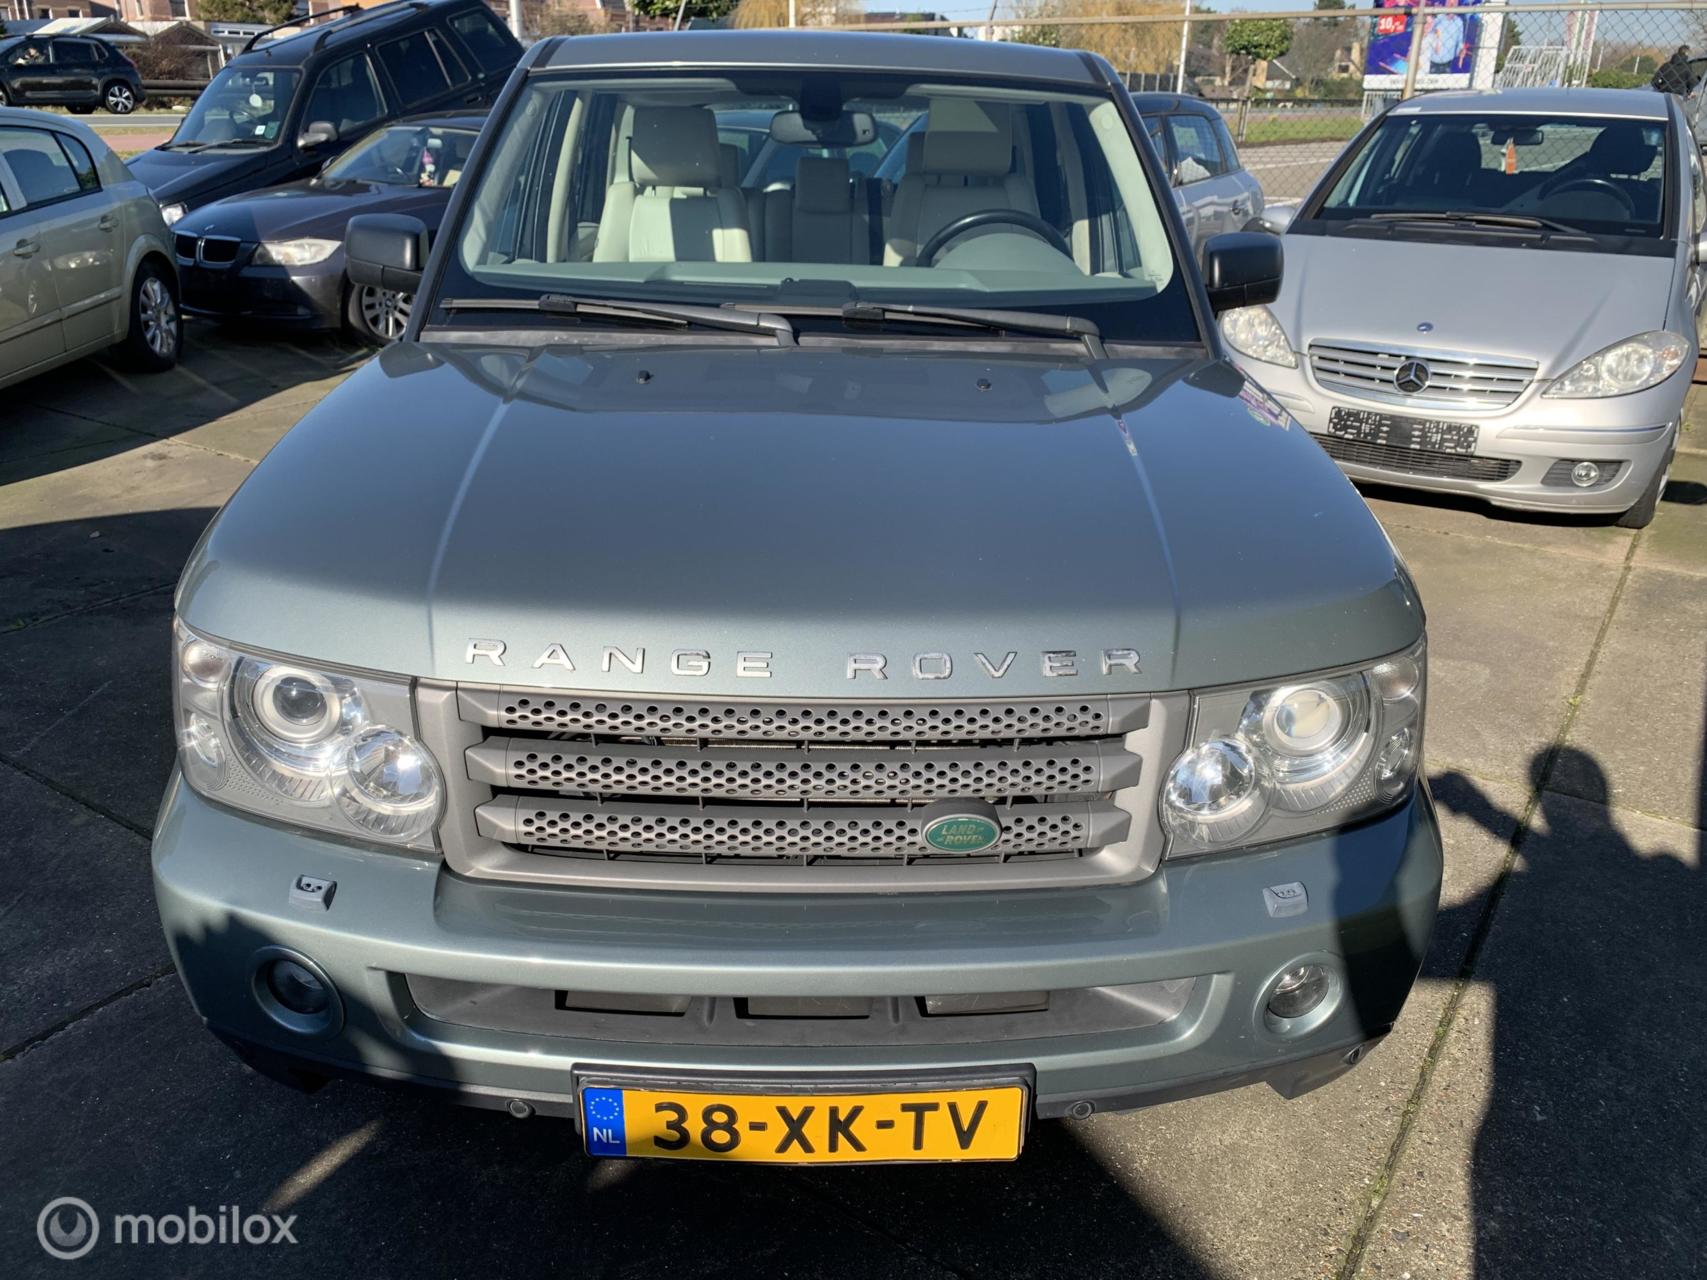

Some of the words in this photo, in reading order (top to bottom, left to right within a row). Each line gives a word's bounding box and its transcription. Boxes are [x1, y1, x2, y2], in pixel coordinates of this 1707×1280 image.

[465, 637, 773, 679] RANGE
[846, 647, 1143, 681] ROVER
[593, 1127, 621, 1145] NL
[653, 1100, 988, 1154] 38-XK-TV
